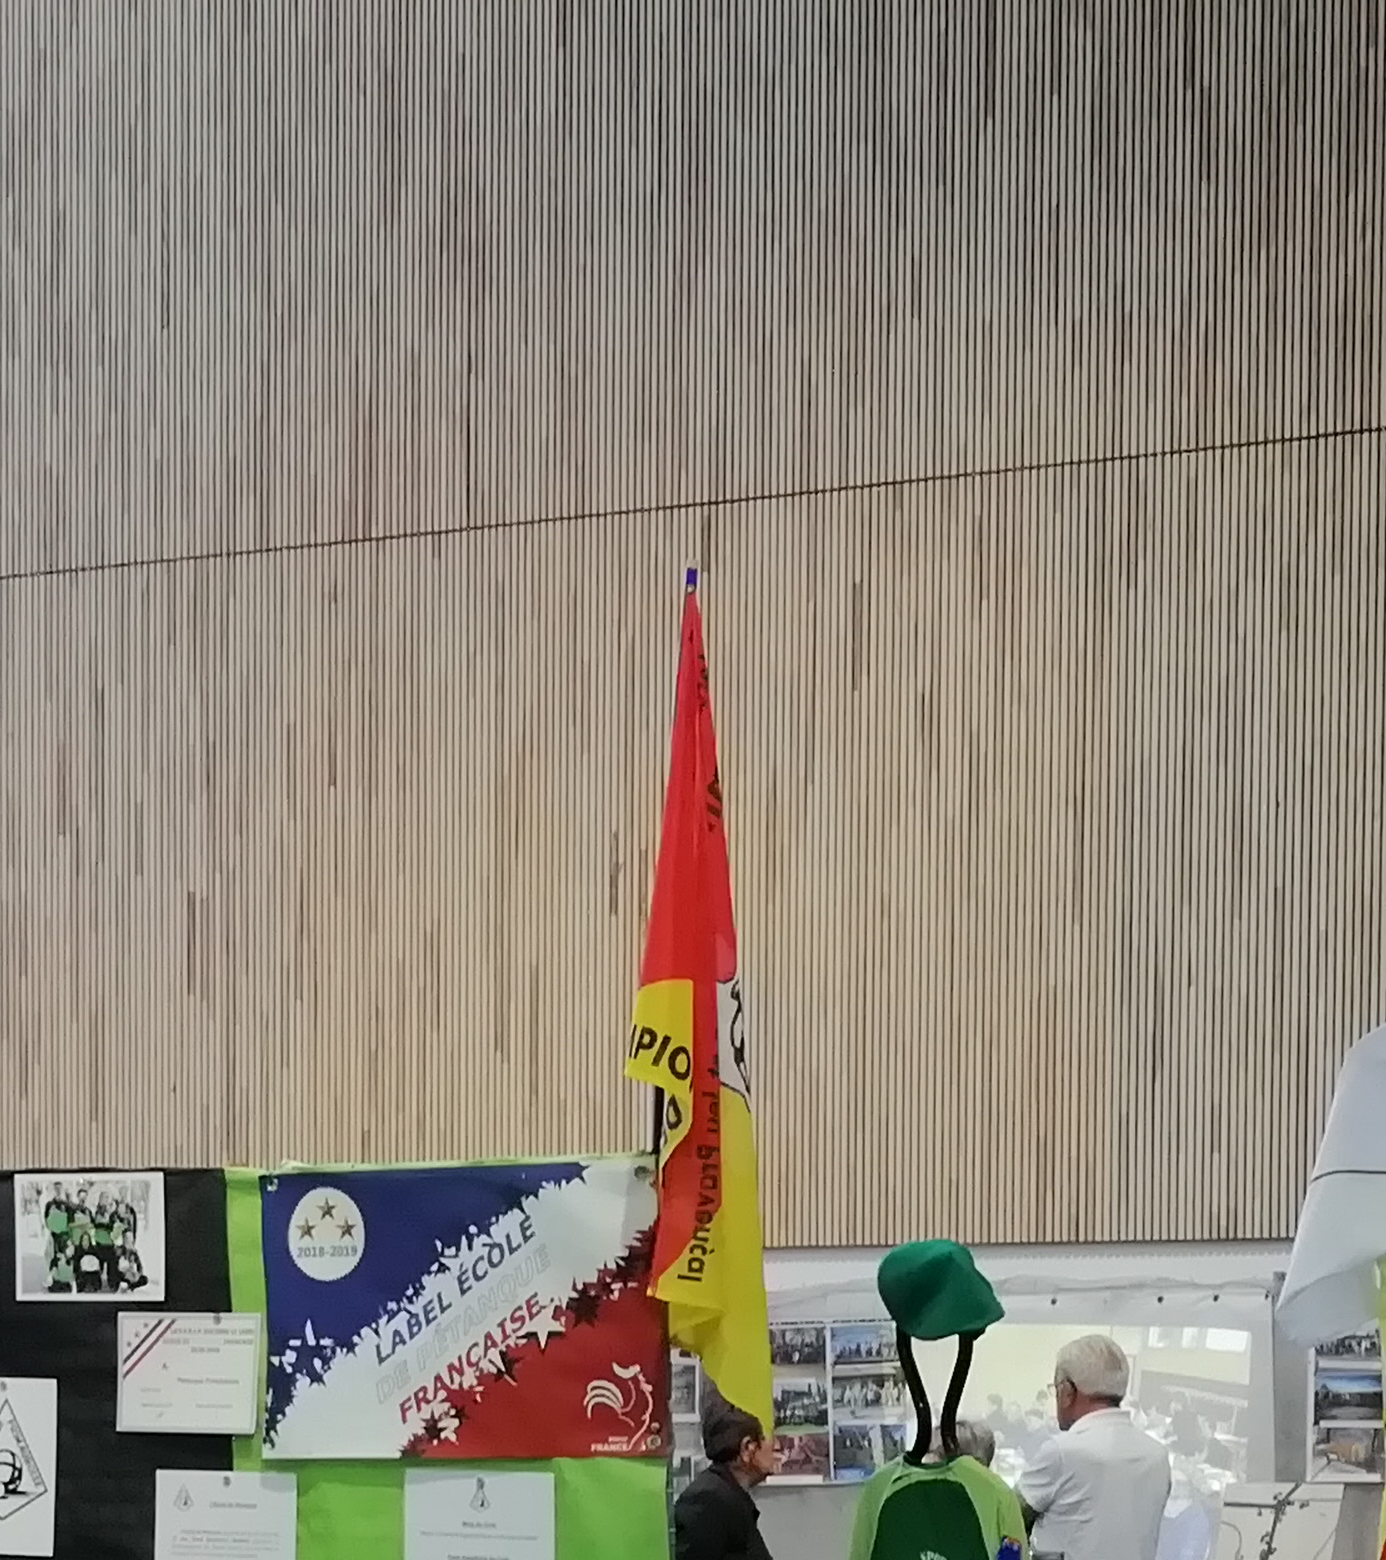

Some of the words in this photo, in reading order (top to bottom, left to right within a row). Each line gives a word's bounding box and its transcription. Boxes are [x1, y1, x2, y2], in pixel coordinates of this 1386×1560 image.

[375, 1366, 411, 1404] DE
[418, 1243, 552, 1373] PÉTANQUE
[376, 1299, 453, 1366] LABEL
[457, 1215, 537, 1297] ÉCOLE
[399, 1292, 541, 1425] FRANÇAISE
